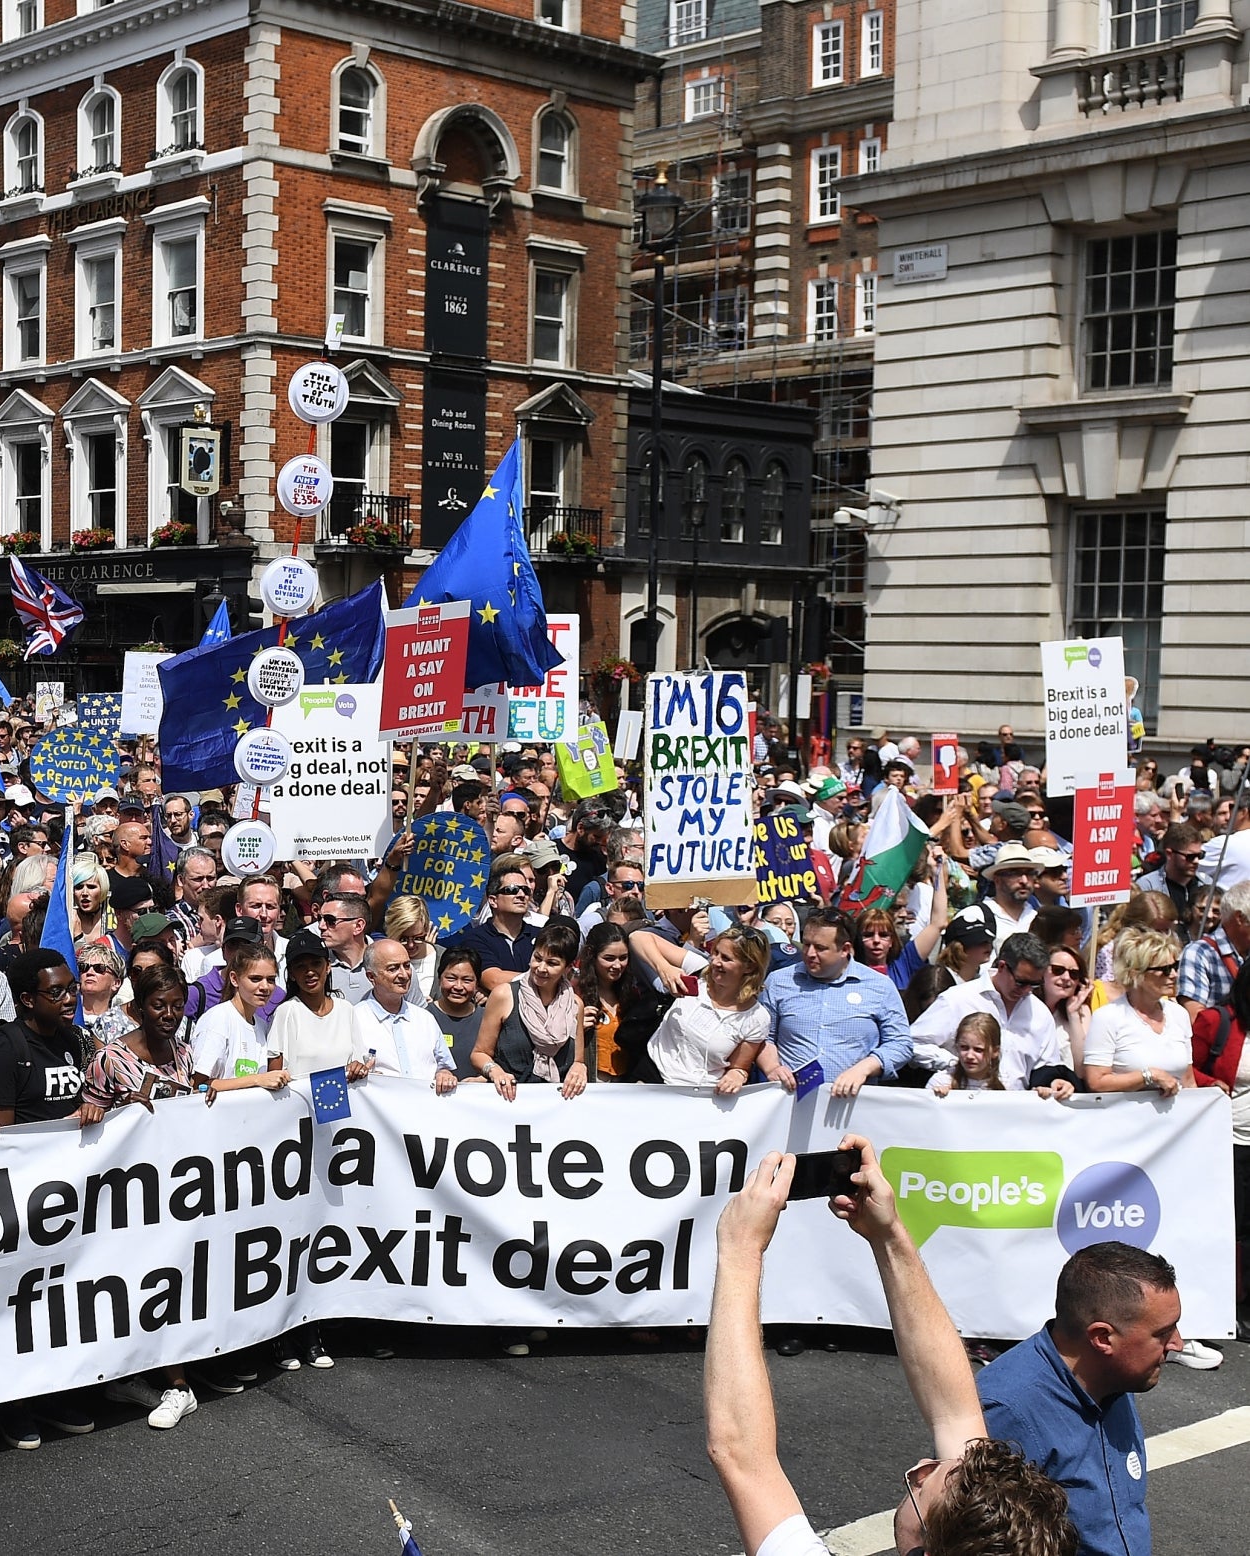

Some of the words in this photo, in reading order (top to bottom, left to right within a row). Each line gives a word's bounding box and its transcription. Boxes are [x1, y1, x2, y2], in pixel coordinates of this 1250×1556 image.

[77, 188, 155, 223] CLARENCE
[899, 248, 942, 262] WHITEHALL
[430, 260, 482, 275] CLARENCE
[445, 300, 467, 315] 1862
[310, 371, 331, 382] THE
[303, 379, 338, 394] STICK
[312, 389, 323, 397] OF
[302, 394, 335, 409] TRUTH
[441, 408, 453, 417] Pub
[455, 410, 467, 419] and
[431, 418, 453, 430] Dining
[454, 420, 476, 430] Rooms
[427, 461, 479, 470] WHITEHALL
[454, 453, 463, 461] 53
[302, 465, 318, 474] THE
[297, 476, 316, 485] NHS
[38, 567, 65, 580] THE
[70, 563, 154, 580] CLARENCE
[278, 584, 305, 594] BREXIT
[411, 637, 451, 656] WANT
[406, 663, 416, 678] A
[418, 660, 445, 677] SAY
[413, 682, 434, 697] ON
[1047, 686, 1084, 702] Brexit
[1087, 685, 1097, 699] is
[1100, 687, 1107, 698] a
[303, 696, 333, 705] People's
[338, 701, 354, 709] Vote
[398, 701, 447, 721] BREXIT
[650, 675, 698, 729] I'M
[700, 673, 745, 737] 16
[507, 700, 565, 739] EU
[1048, 707, 1068, 723] big
[1071, 704, 1101, 720] deal,
[1104, 702, 1124, 716] not
[397, 724, 442, 737] LABOURSAY.EU
[1049, 730, 1056, 740] a
[1059, 725, 1091, 740] done
[1094, 721, 1123, 738] deal.
[332, 736, 347, 752] is
[352, 740, 362, 752] a
[47, 744, 104, 772] SCOTLAND
[650, 733, 748, 774] BREXIT
[55, 760, 88, 771] VOTED
[250, 763, 276, 772] ENTITY
[306, 758, 352, 777] deal,
[357, 757, 388, 773] not
[46, 769, 99, 788] REMAIN
[274, 785, 283, 797] a
[289, 781, 336, 797] done
[341, 779, 386, 795] deal.
[655, 772, 744, 811] STOLE
[1087, 806, 1093, 821] I
[1093, 804, 1123, 820] WANT
[678, 808, 726, 836] MY
[773, 816, 798, 839] Us
[293, 834, 372, 844] www.Peoples-Vote.UK
[1089, 828, 1098, 843] A
[1098, 826, 1118, 842] SAY
[416, 839, 469, 862] PERTH
[648, 836, 756, 877] FUTURE!
[1095, 849, 1111, 864] ON
[424, 857, 455, 876] FOR
[1084, 869, 1119, 887] BREXIT
[402, 873, 465, 904] EUROPE
[327, 1127, 376, 1187] a
[403, 1124, 604, 1200] vote
[629, 1138, 749, 1200] on
[900, 1171, 1047, 1212] People's
[1074, 1200, 1146, 1229] Vote
[8, 1239, 210, 1355] final
[233, 1210, 472, 1312] Brexit
[491, 1218, 695, 1296] deal
